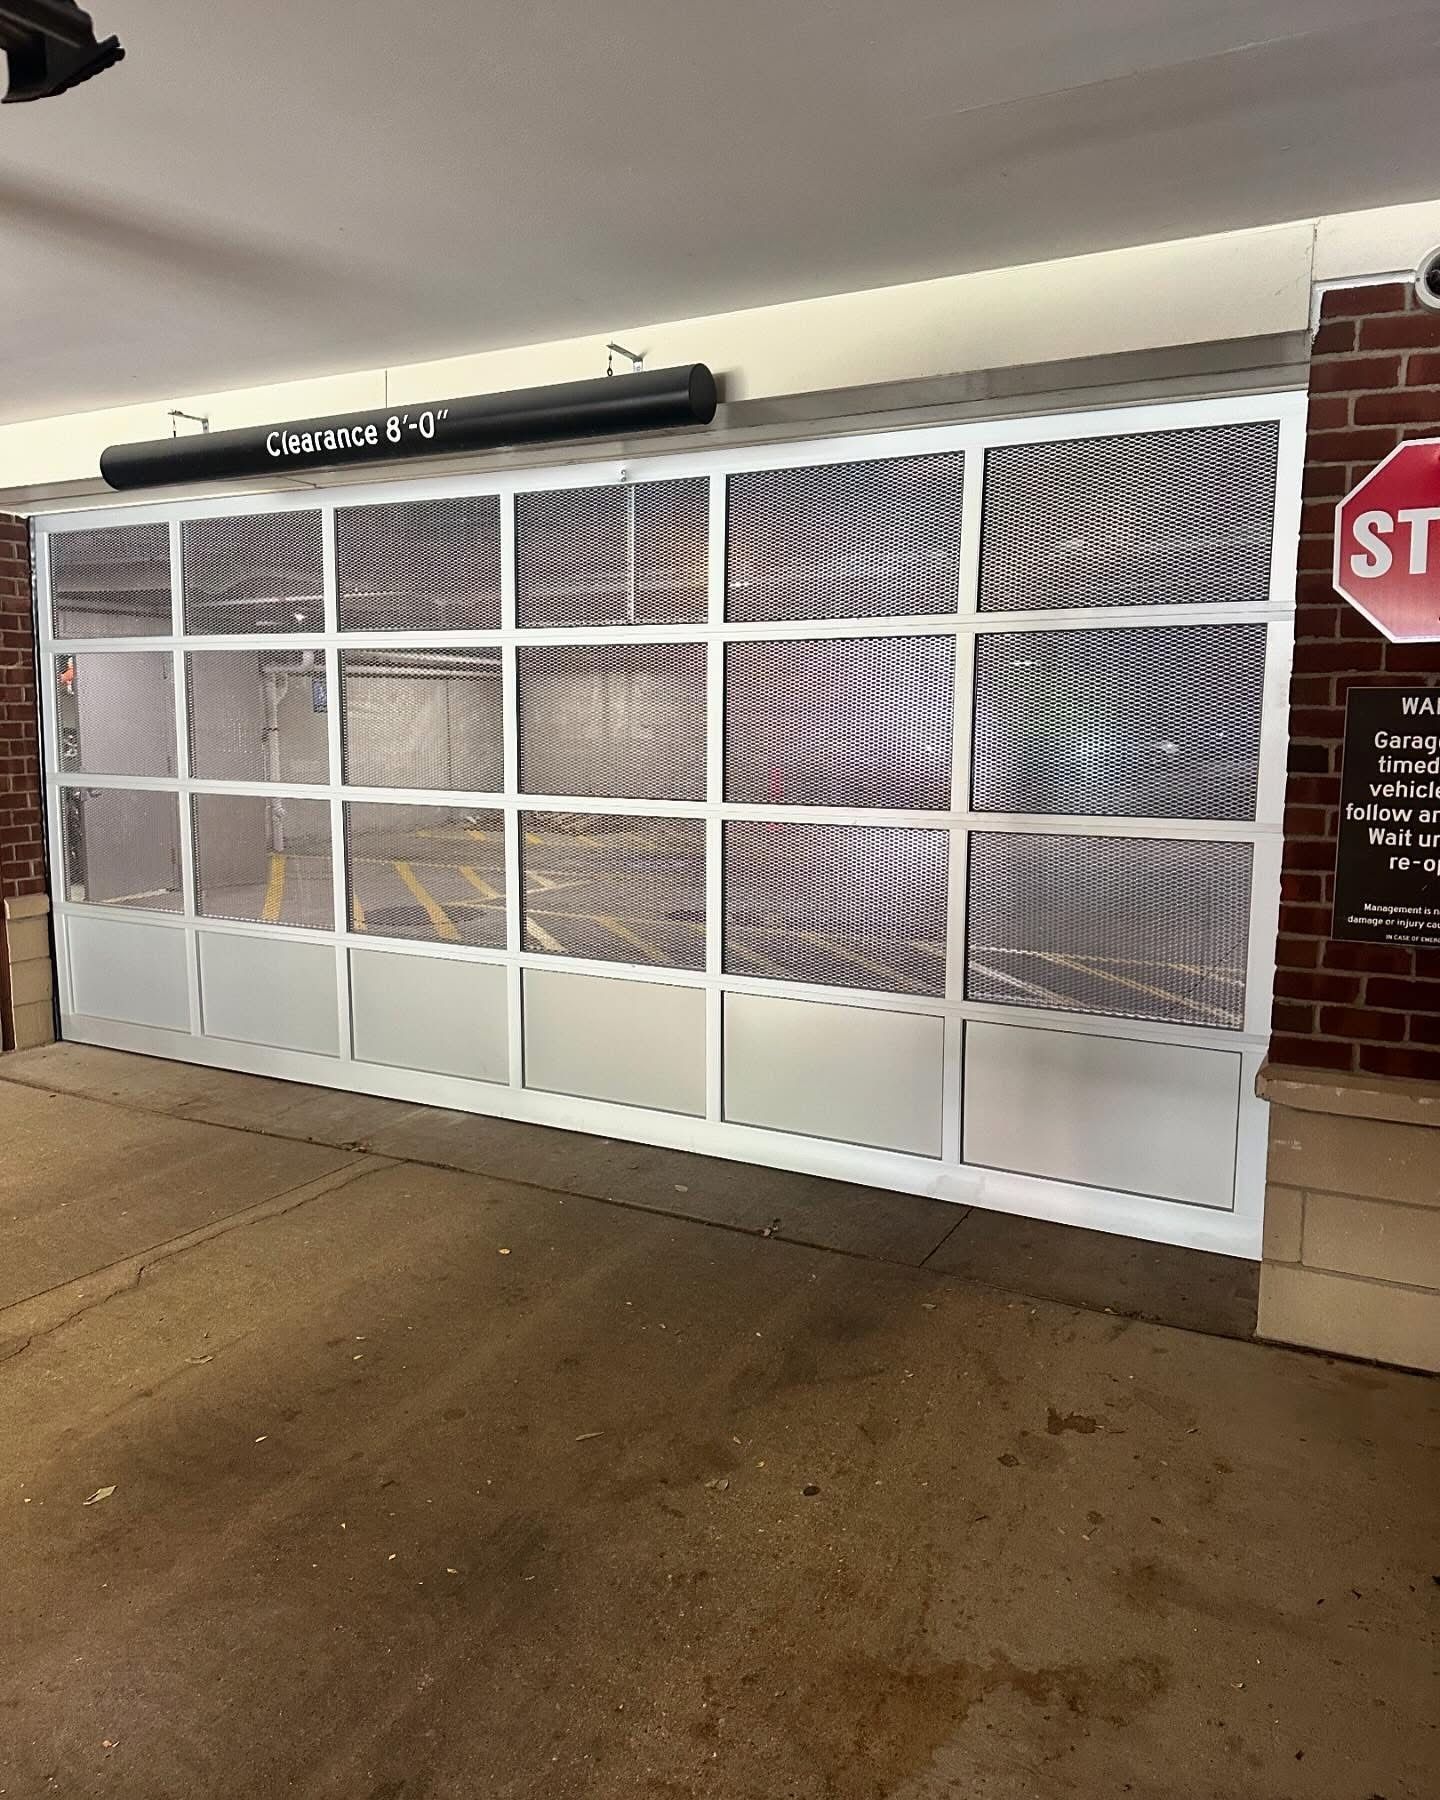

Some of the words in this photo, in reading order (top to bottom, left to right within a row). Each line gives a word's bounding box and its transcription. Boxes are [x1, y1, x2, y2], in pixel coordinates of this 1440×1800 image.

[266, 424, 379, 457] Clearance
[1374, 731, 1440, 755] Garag
[1378, 755, 1440, 774] timed
[1345, 802, 1413, 822] follow
[1368, 827, 1412, 846] Wait
[1364, 903, 1422, 914] Management
[1424, 907, 1432, 915] is
[1347, 915, 1383, 927] damage
[1397, 918, 1425, 930] injury
